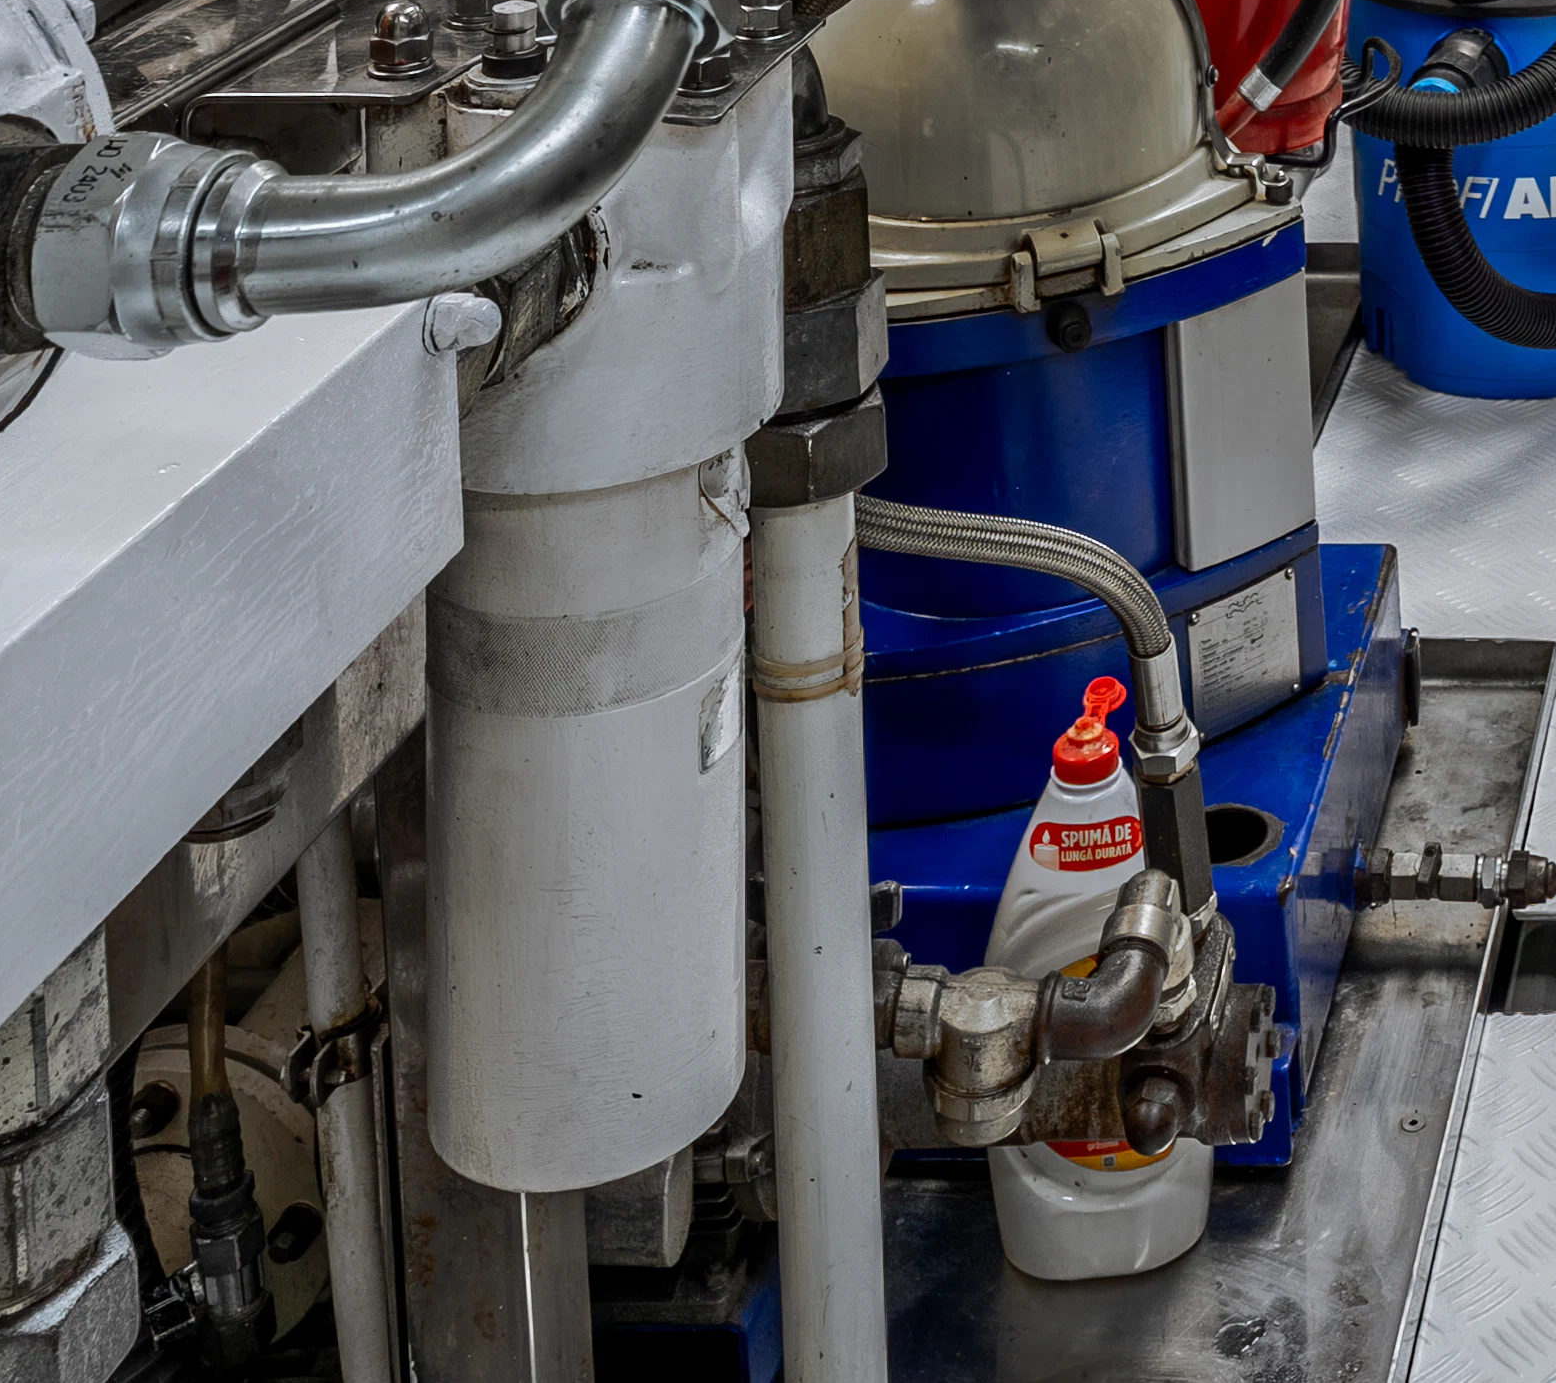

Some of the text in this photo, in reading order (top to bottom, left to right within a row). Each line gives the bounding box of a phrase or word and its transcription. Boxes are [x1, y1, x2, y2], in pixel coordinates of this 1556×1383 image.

[1378, 158, 1499, 219] PFI
[1061, 822, 1132, 848] SPUMĂ DE
[1061, 841, 1132, 862] LUNGĂ DURATĂ
